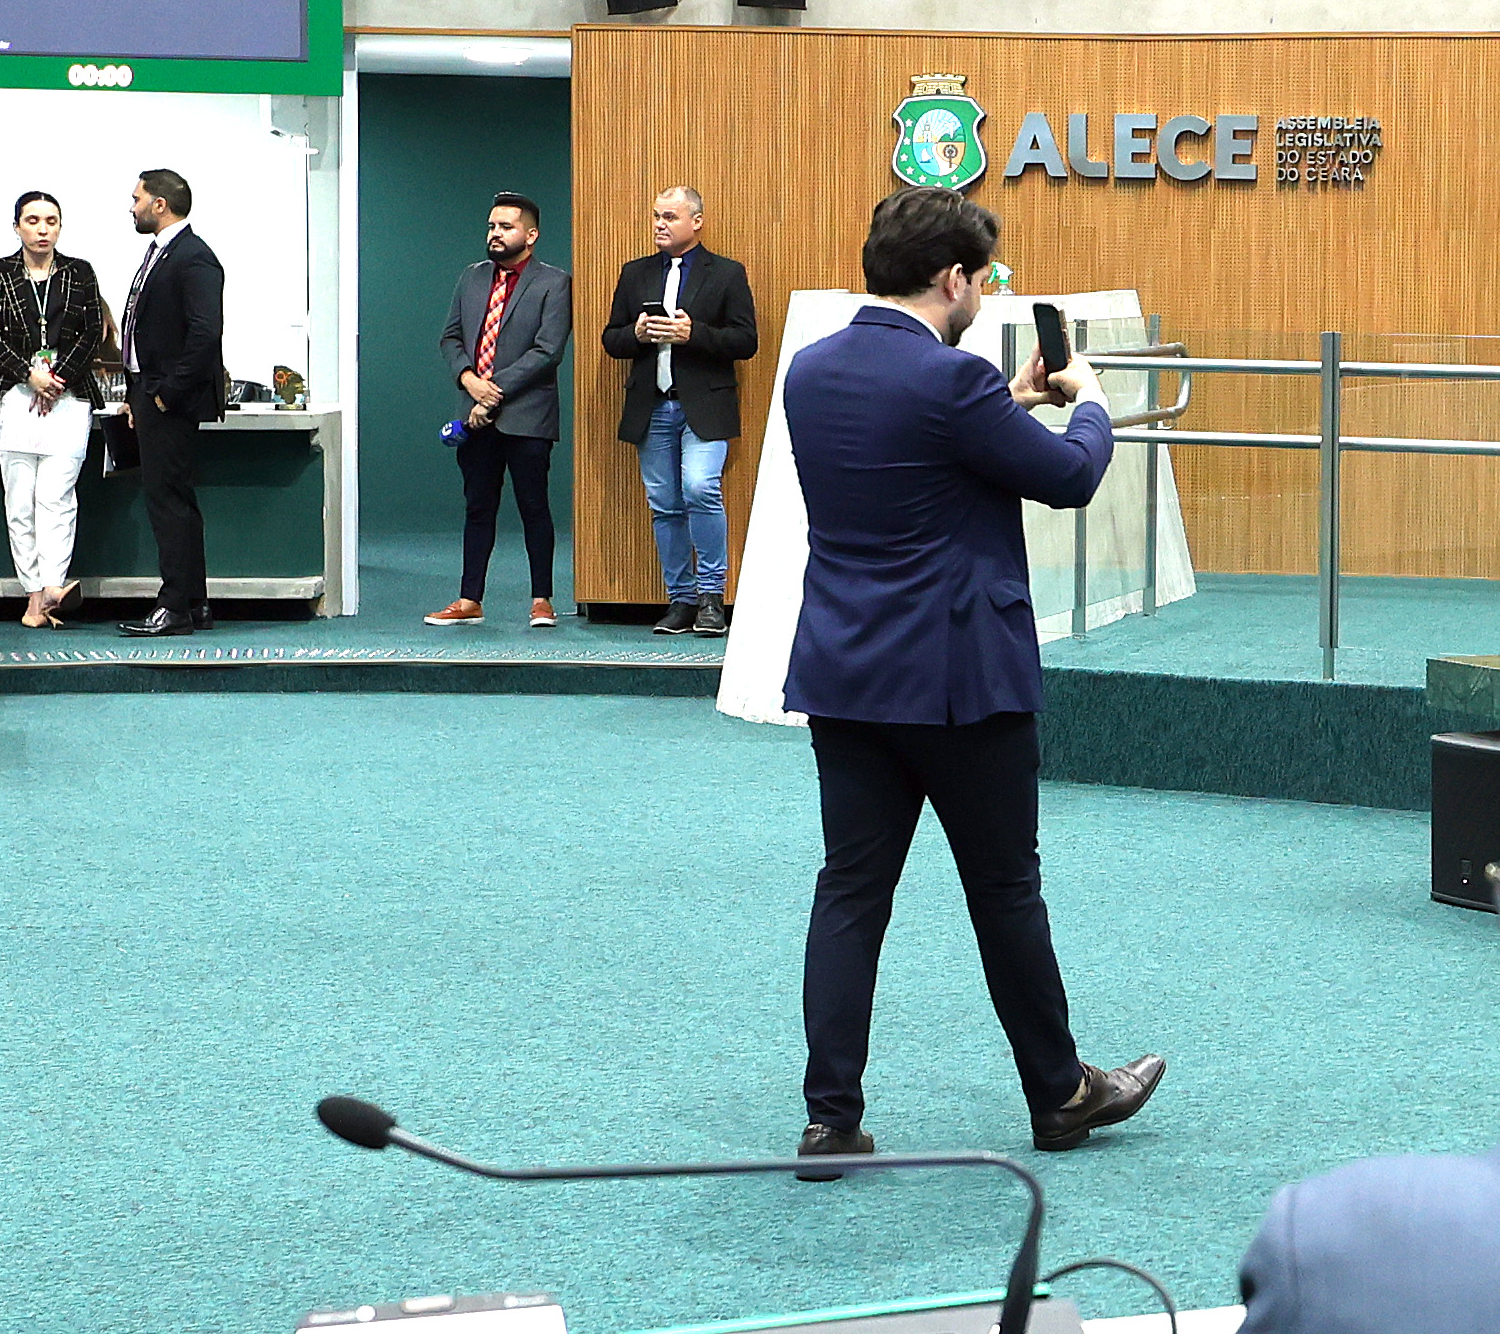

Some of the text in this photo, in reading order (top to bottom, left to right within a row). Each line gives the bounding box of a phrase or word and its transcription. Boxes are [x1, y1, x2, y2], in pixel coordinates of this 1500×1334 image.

[67, 62, 134, 88] 00:00
[1276, 116, 1381, 130] ASSEMBLEIA
[1003, 113, 1258, 181] ALECE
[1276, 133, 1382, 147] LEGISLATIVA
[1276, 150, 1373, 165] DO ESTADO
[1276, 164, 1364, 182] DO CEARÁ
